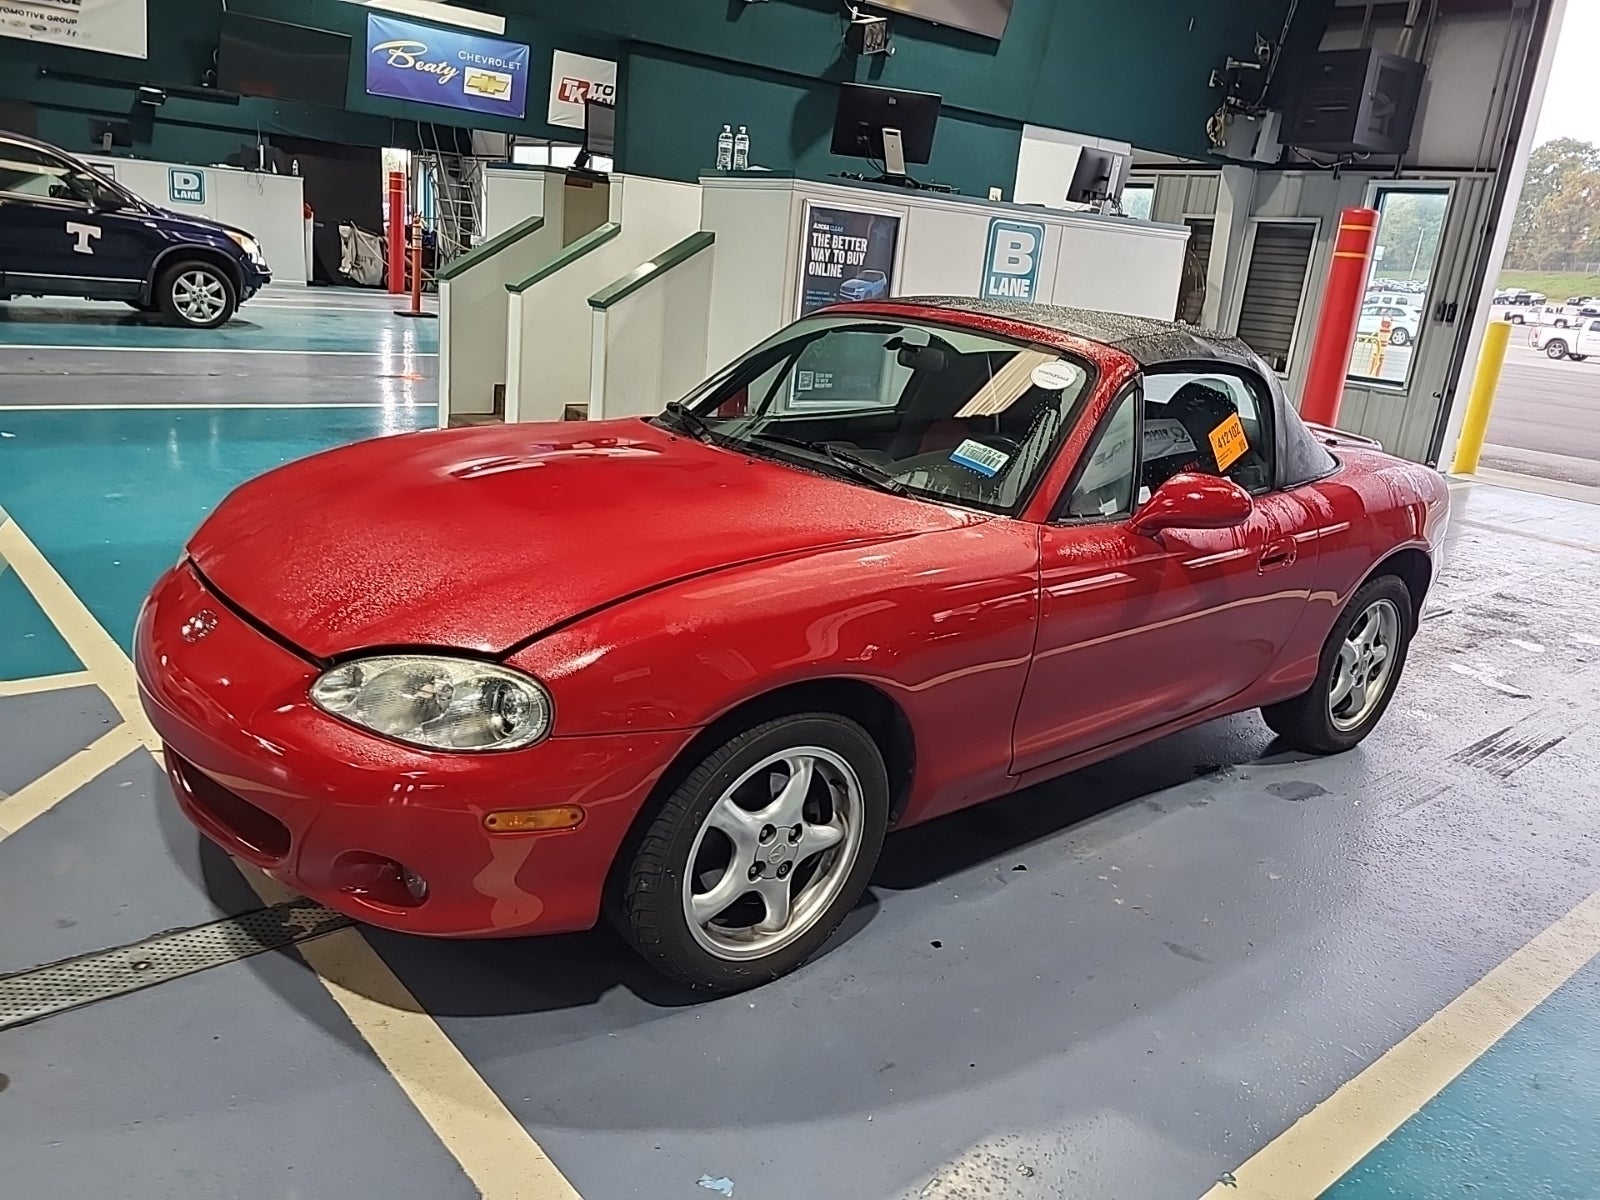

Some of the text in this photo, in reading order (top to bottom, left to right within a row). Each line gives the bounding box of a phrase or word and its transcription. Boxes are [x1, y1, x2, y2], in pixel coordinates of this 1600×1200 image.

[46, 14, 78, 25] GROUP
[371, 40, 460, 85] Beaty
[458, 50, 522, 71] CHEVROLET
[561, 78, 588, 104] TK
[174, 172, 199, 190] D
[174, 190, 201, 201] LANE
[66, 221, 101, 255] T
[812, 233, 868, 252] THE BETTER
[810, 246, 866, 266] WAY TO BUY
[992, 229, 1036, 275] B
[808, 262, 844, 278] ONLINE
[988, 276, 1031, 298] LANE
[1217, 422, 1242, 449] 412102
